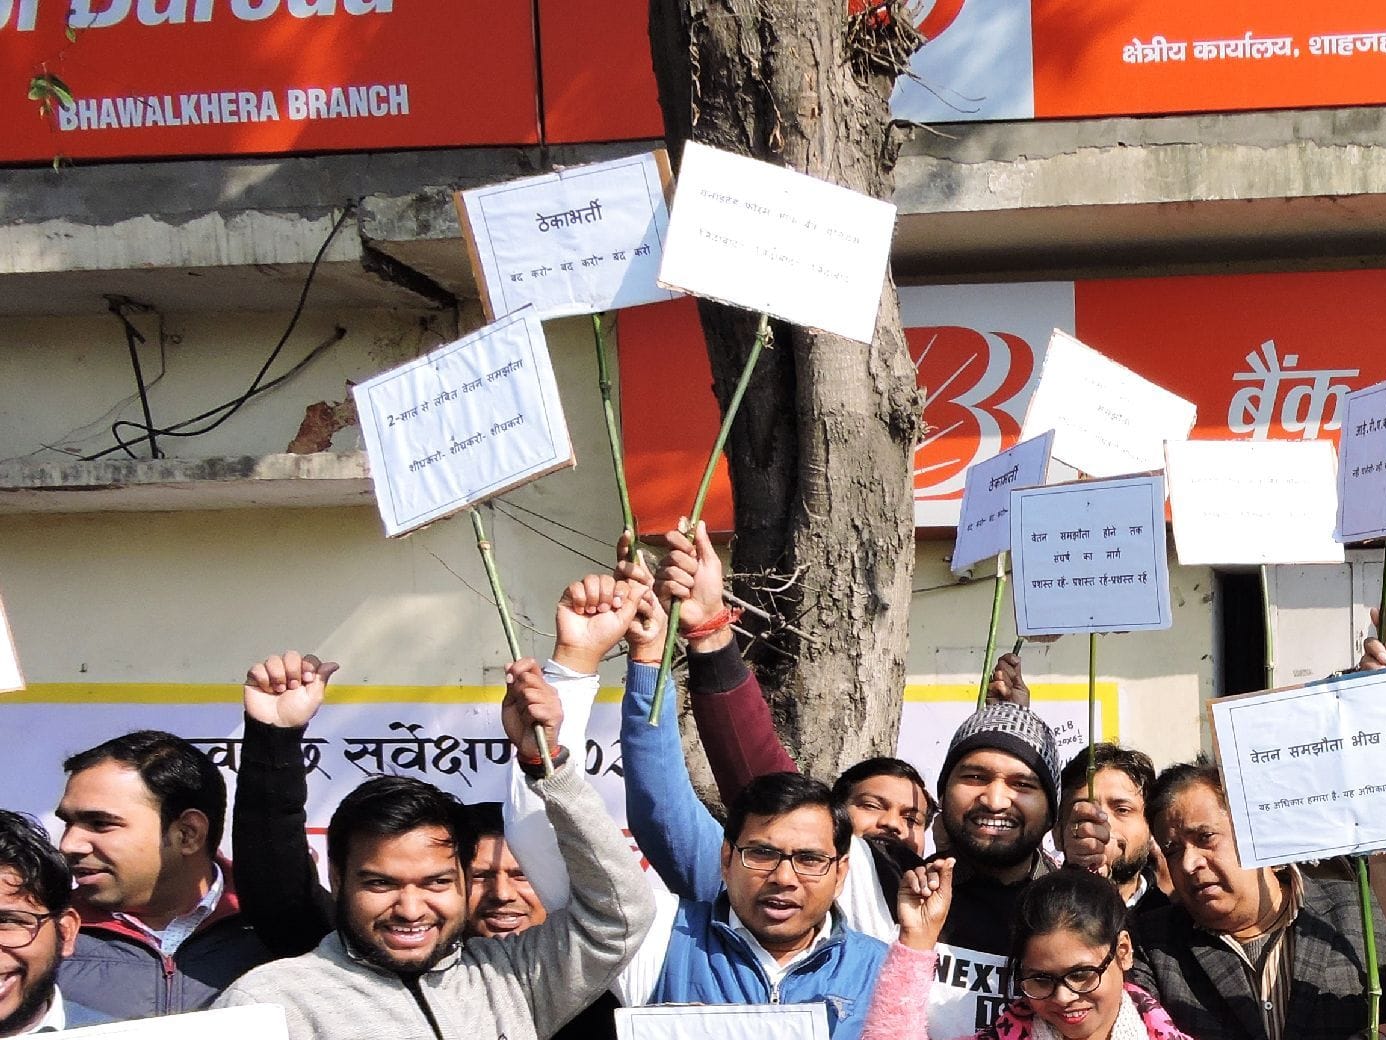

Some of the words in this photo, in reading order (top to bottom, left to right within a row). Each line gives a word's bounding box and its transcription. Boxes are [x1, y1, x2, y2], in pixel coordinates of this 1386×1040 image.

[1122, 35, 1187, 64] क्षेत्रीय
[1193, 31, 1299, 60] कार्यालय,
[59, 92, 280, 132] BHAWALKHERA
[287, 84, 410, 121] BRANCH
[536, 198, 603, 234] ठेकाभर्ती
[486, 359, 524, 384] समझौता
[1250, 748, 1281, 765] वेतन
[1288, 737, 1344, 759] समझौता
[1351, 730, 1381, 747] भीख
